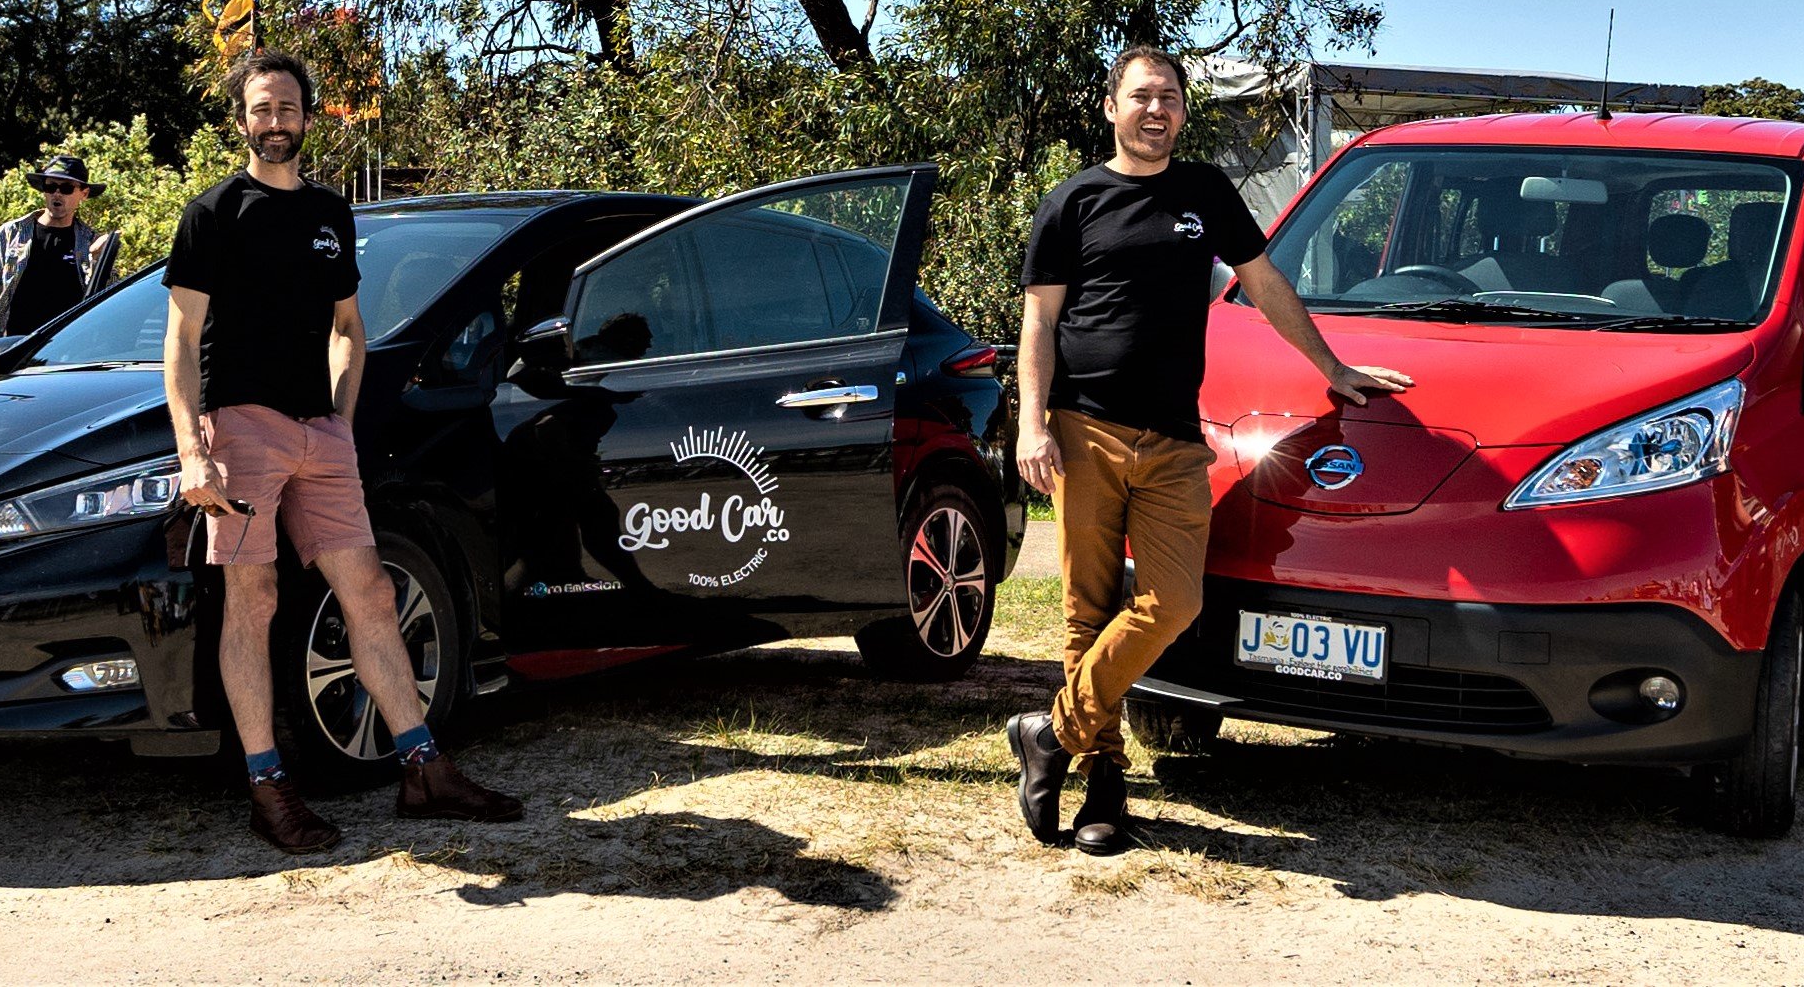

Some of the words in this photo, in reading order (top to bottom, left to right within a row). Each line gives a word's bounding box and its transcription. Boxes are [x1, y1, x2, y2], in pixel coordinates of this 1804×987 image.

[618, 492, 715, 552] Good
[721, 494, 785, 543] Car
[688, 573, 719, 587] 100%
[720, 547, 768, 587] ELECTRIC
[1343, 628, 1382, 668] VU
[1275, 664, 1343, 681] GOODCAR.CO
